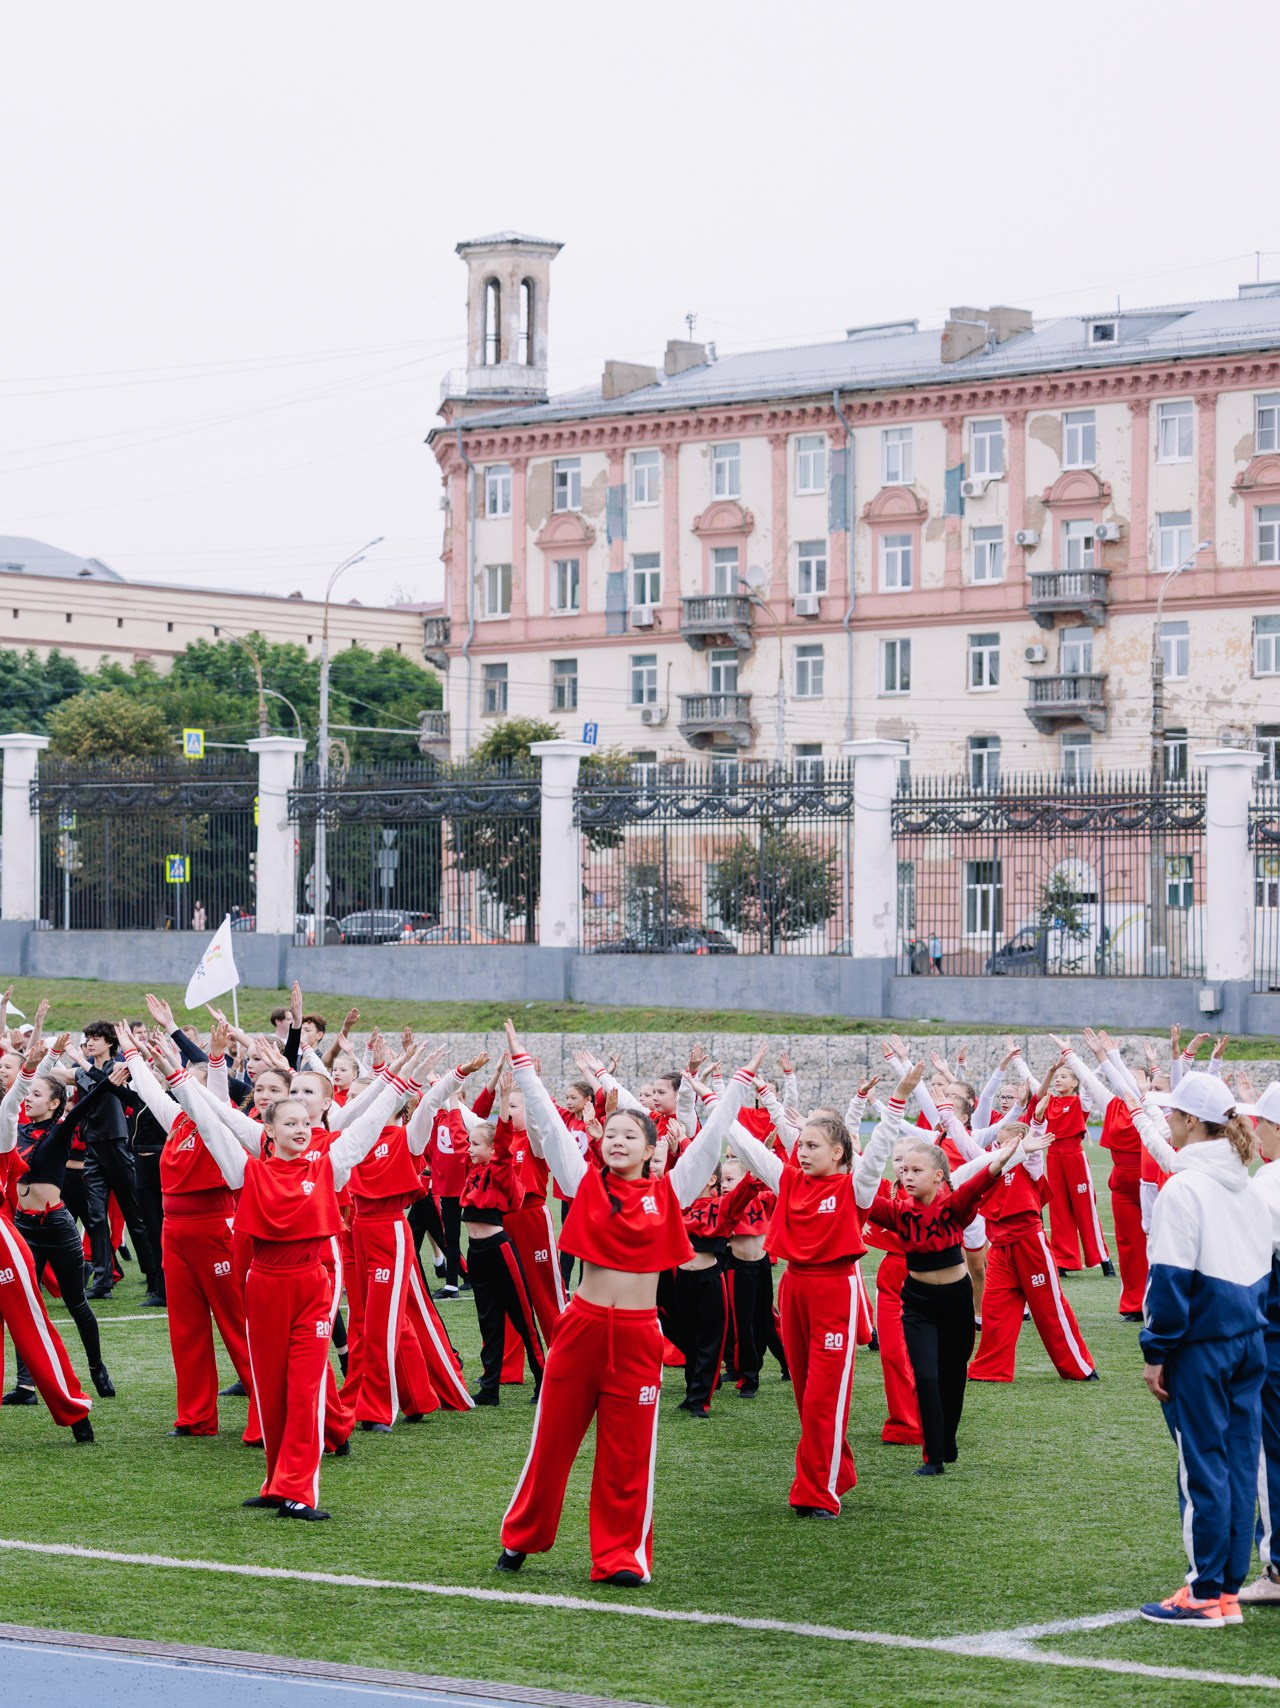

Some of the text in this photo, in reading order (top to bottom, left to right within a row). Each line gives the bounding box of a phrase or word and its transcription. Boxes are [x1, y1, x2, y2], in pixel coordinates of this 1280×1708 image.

[374, 1143, 388, 1156] 20
[1077, 1183, 1087, 1192] 20
[819, 1195, 836, 1210] 20
[535, 1250, 548, 1260] 20
[214, 1261, 230, 1274] 20
[375, 1268, 390, 1281] 20
[1031, 1273, 1045, 1284] 20
[316, 1321, 330, 1335] 20
[825, 1332, 843, 1347] 20
[639, 1385, 656, 1401] 20
